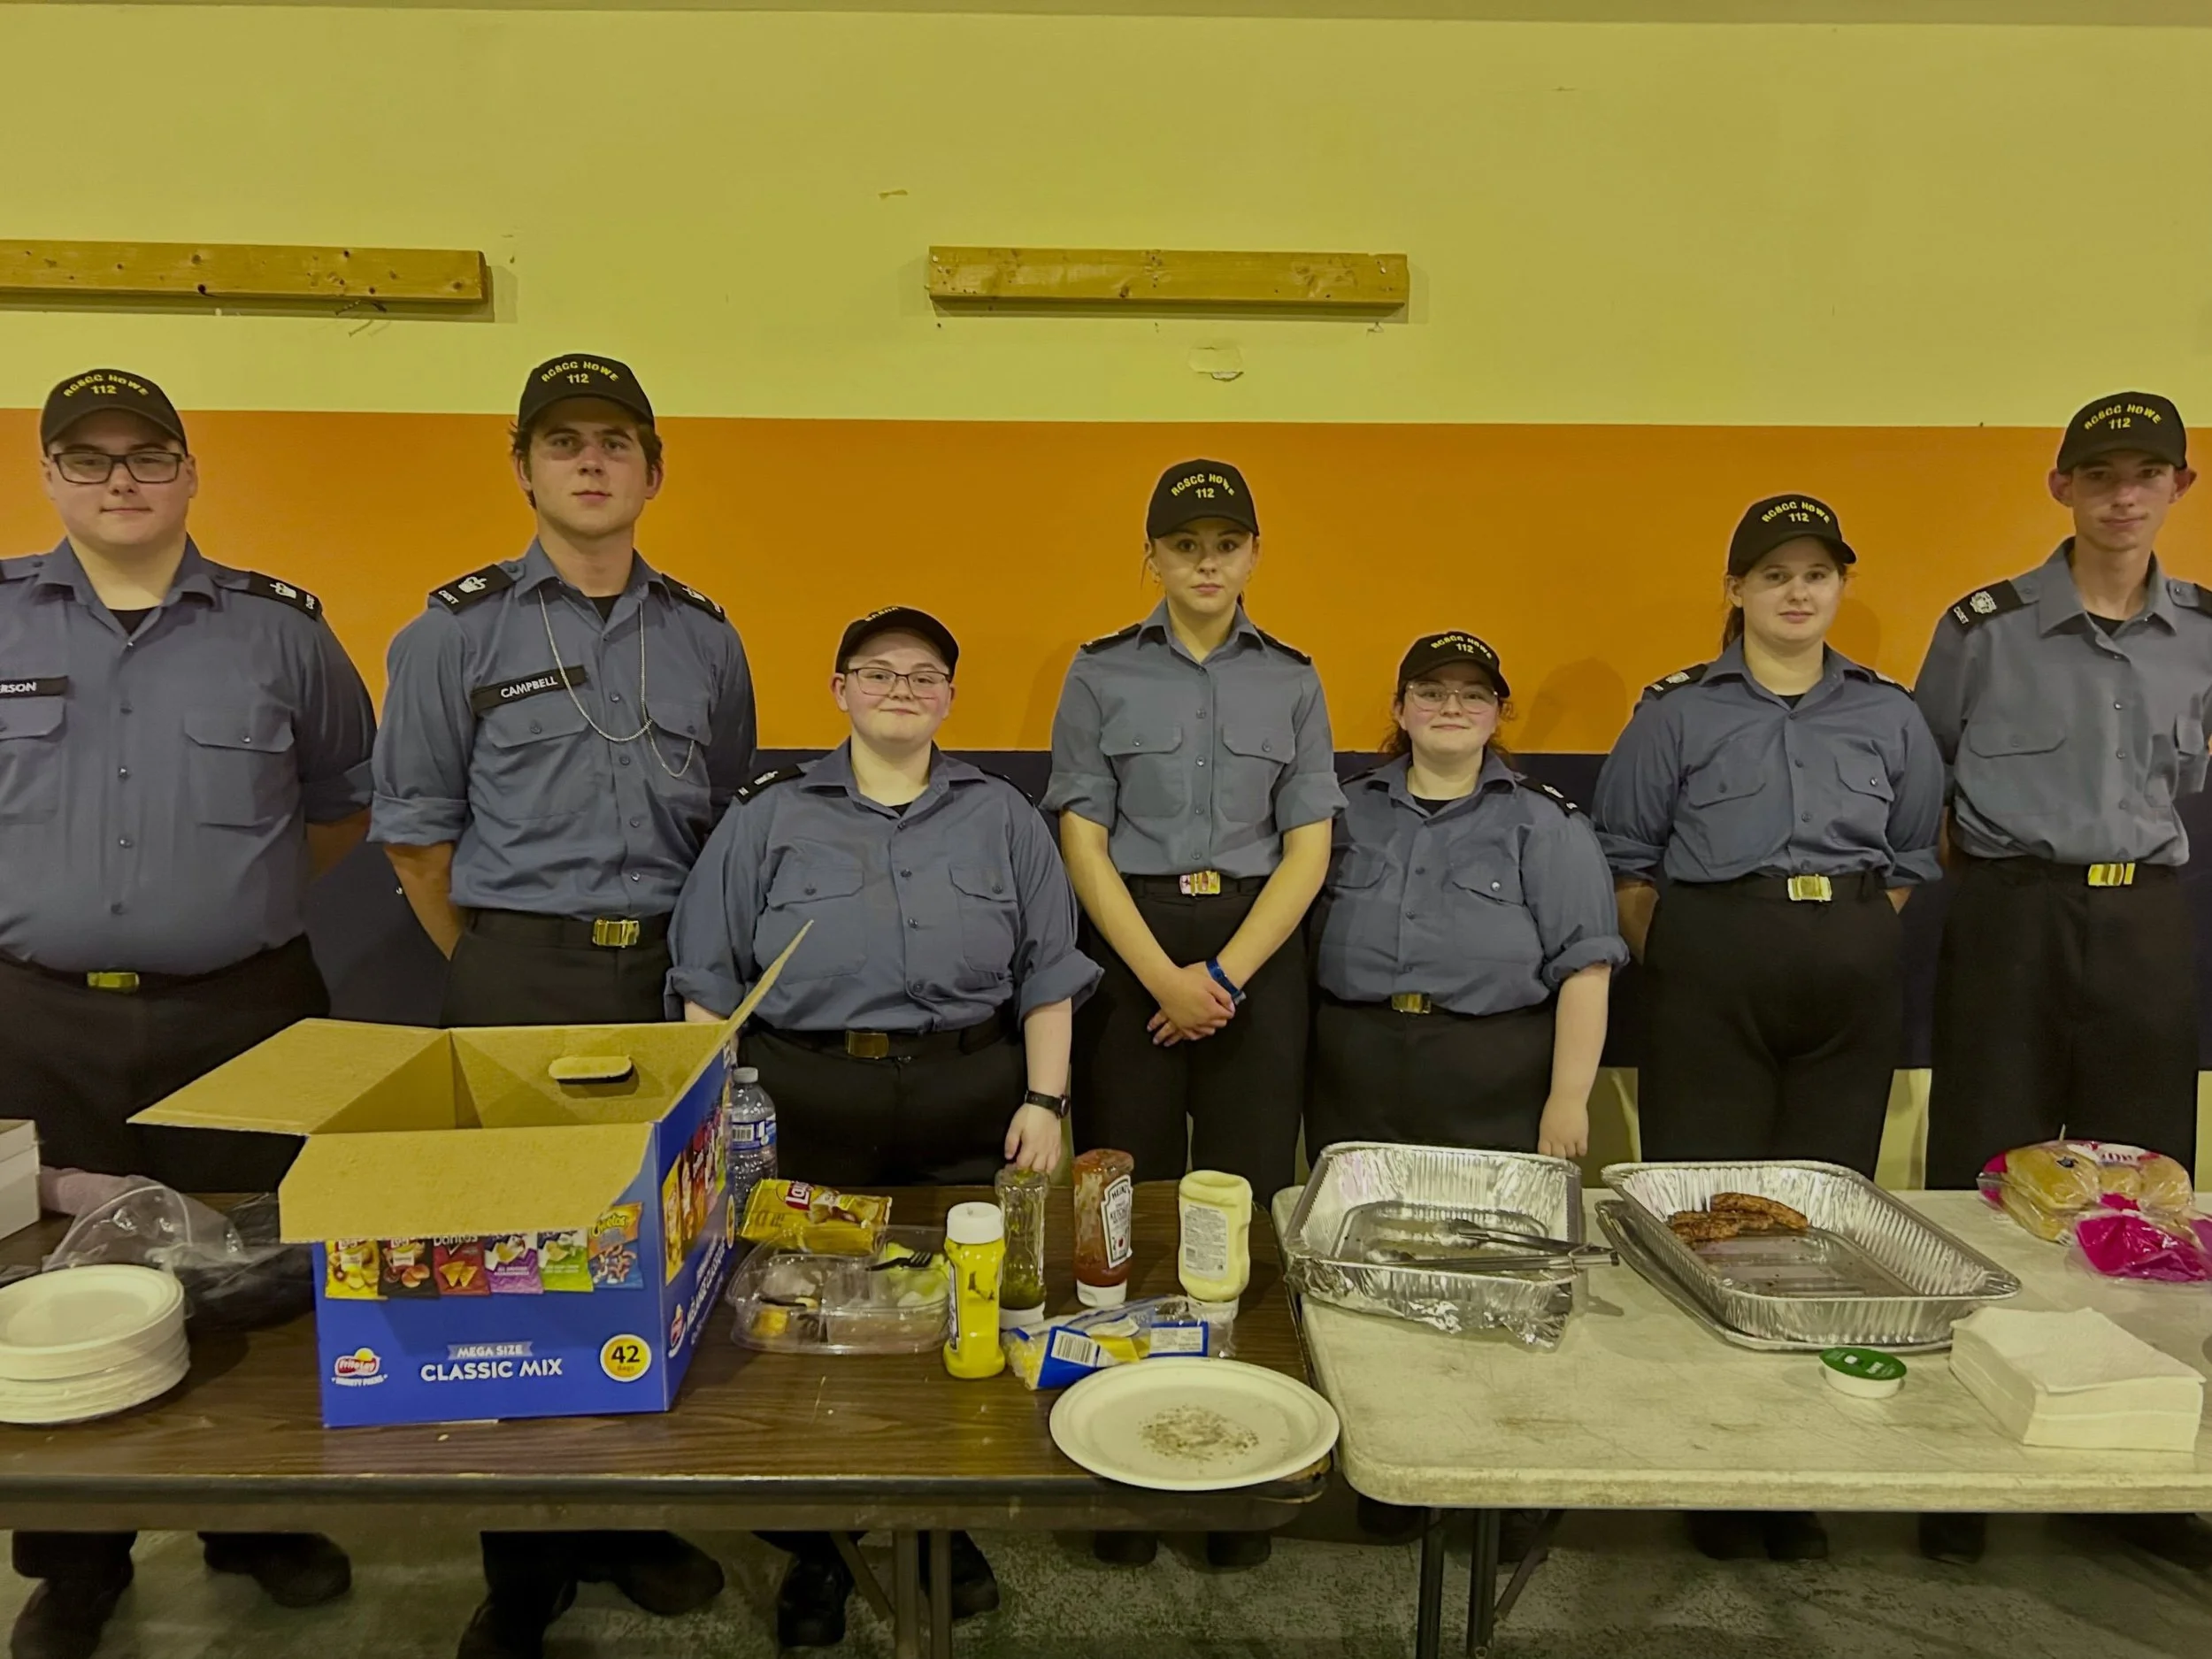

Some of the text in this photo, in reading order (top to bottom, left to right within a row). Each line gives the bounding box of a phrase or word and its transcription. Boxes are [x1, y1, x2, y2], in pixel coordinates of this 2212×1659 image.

[541, 361, 620, 382] RCSCC HOWE
[567, 373, 589, 384] 112
[90, 385, 118, 395] 112
[108, 374, 149, 396] HOWE
[2126, 403, 2162, 425] HOWE
[2108, 417, 2131, 429] 112
[1171, 473, 1205, 496] RCSCC
[1195, 488, 1215, 498] 112
[1788, 512, 1810, 522] 112
[1801, 501, 1831, 524] HOWE
[1455, 643, 1474, 653] 112
[0, 681, 37, 694] RSON
[500, 675, 558, 698] CAMPBELL
[457, 1344, 524, 1357] MEGA SIZE
[611, 1345, 641, 1363] 42
[420, 1358, 563, 1382] CLASSIC MIX
